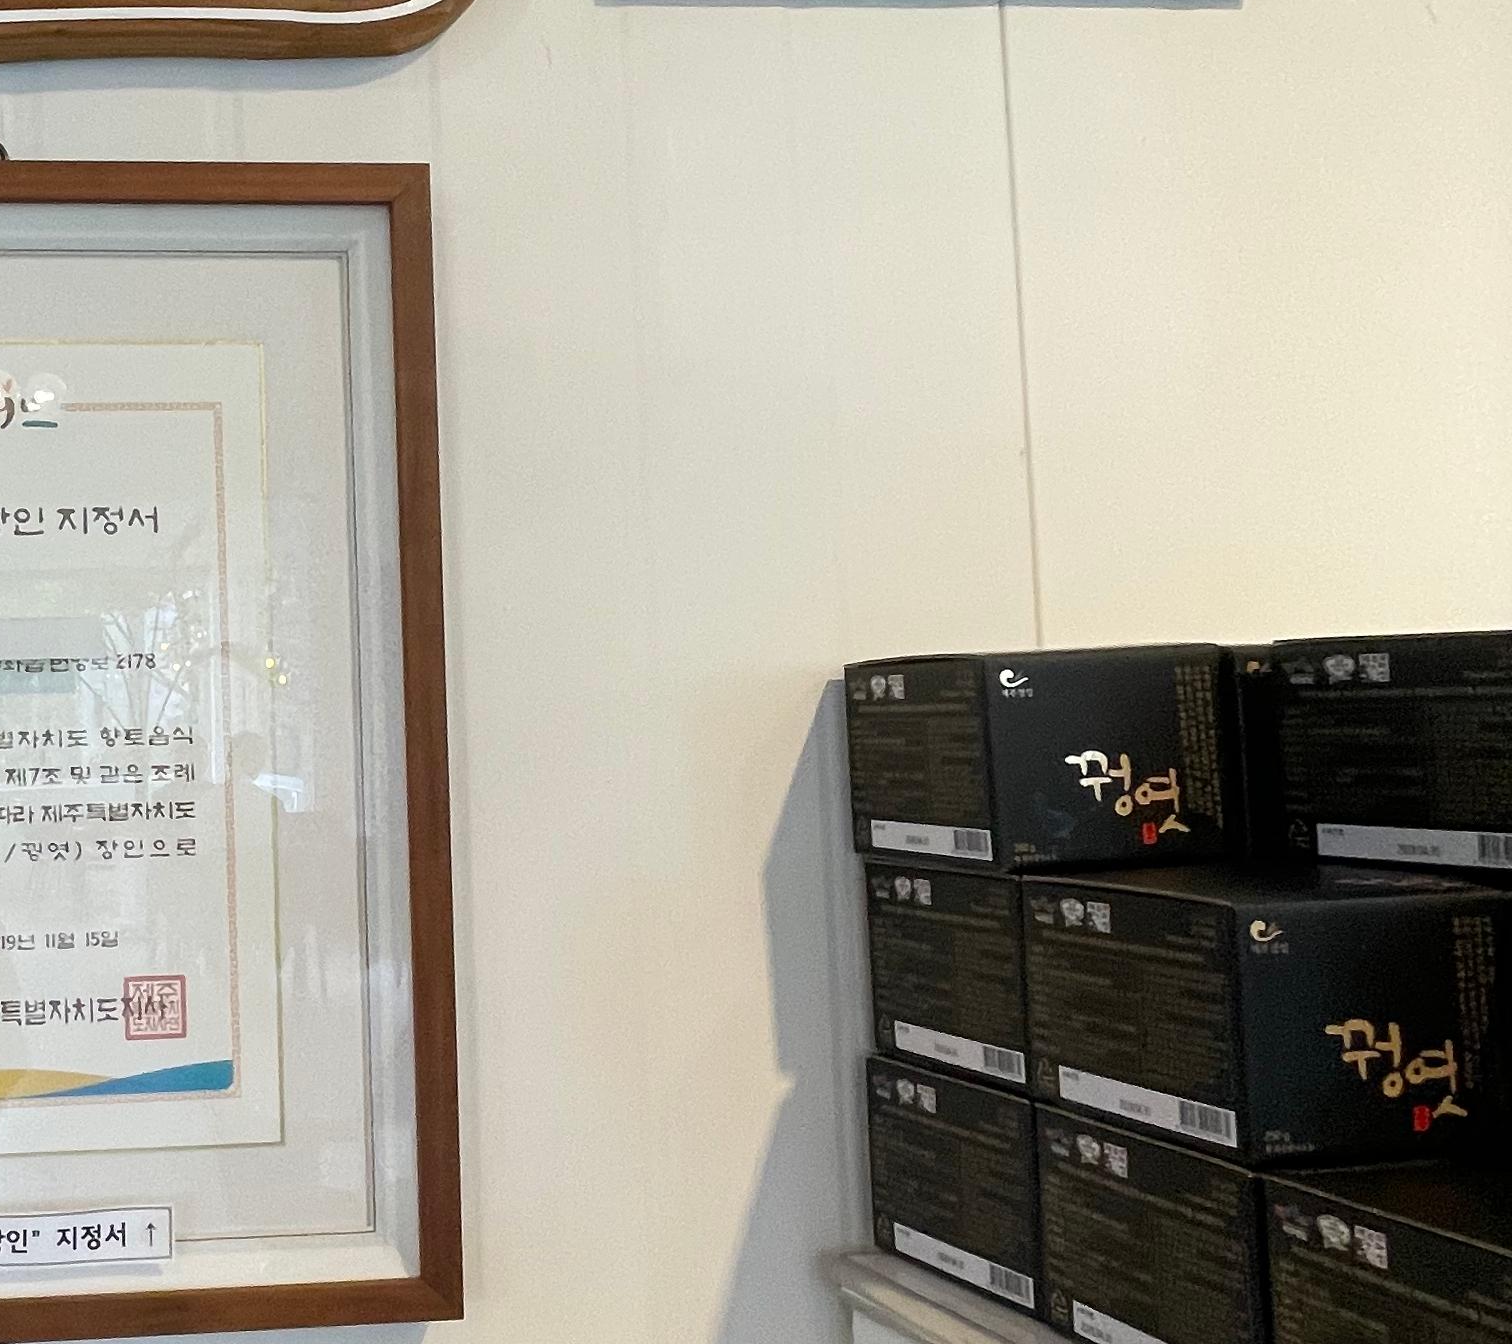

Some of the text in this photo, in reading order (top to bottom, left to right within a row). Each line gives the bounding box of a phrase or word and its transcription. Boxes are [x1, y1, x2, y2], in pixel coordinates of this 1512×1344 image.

[58, 505, 159, 535] 지정서
[100, 725, 195, 747] 향토음식
[5, 766, 63, 787] 제7조
[71, 765, 92, 786] 및
[100, 764, 145, 786] 같은
[150, 761, 196, 783] 조례
[40, 799, 197, 823] 제주특별자치도
[94, 836, 197, 860] 장인으로
[44, 932, 75, 951] 11월
[85, 930, 120, 949] 15일
[56, 1221, 127, 1251] 지정서
